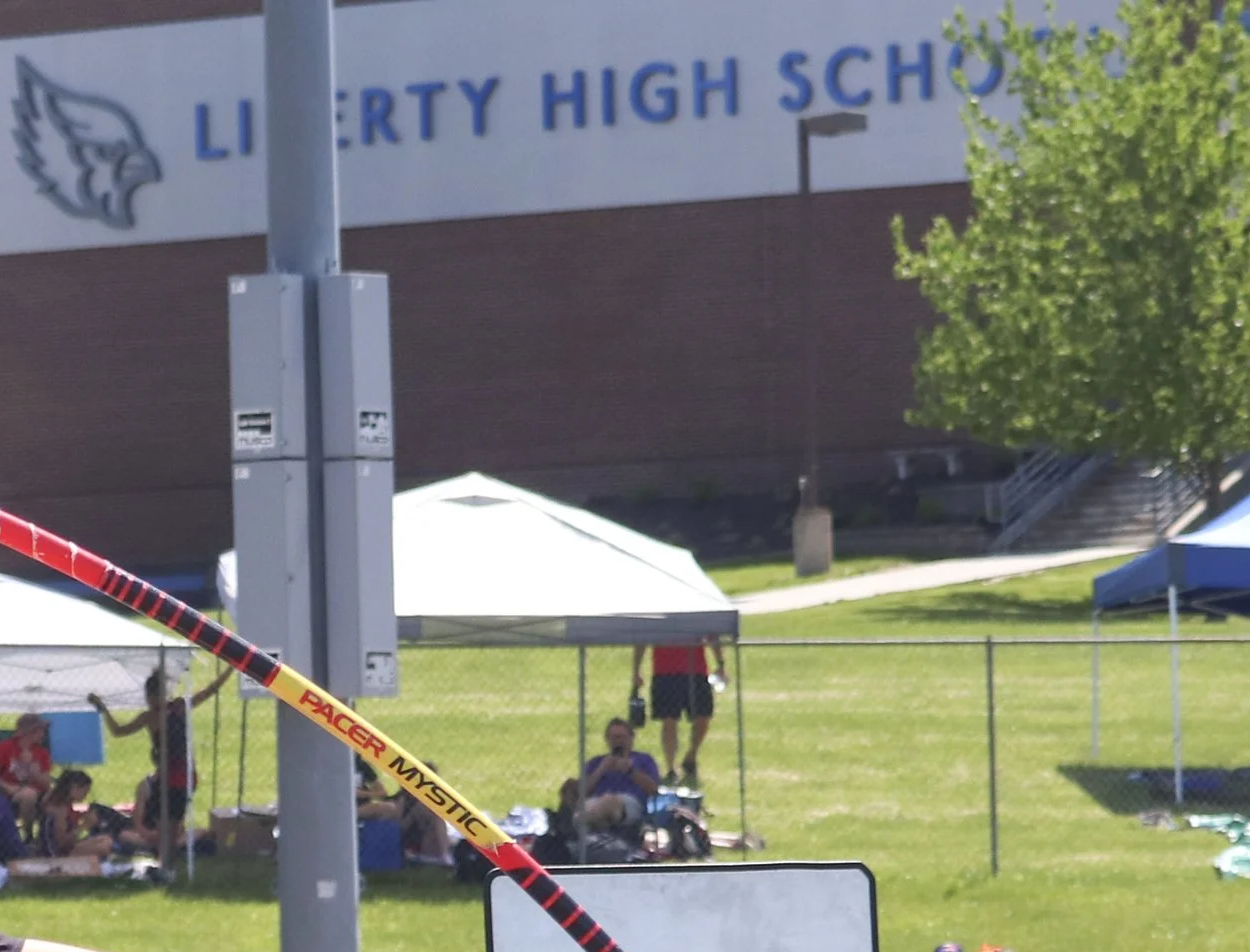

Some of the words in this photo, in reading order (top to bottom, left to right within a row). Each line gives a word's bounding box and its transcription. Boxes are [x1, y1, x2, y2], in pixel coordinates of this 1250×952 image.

[195, 74, 501, 160] LIRTY
[541, 55, 739, 130] HIGH
[778, 26, 1127, 112] SCHO
[299, 689, 387, 759] PACER
[388, 755, 488, 837] MYSTIC
